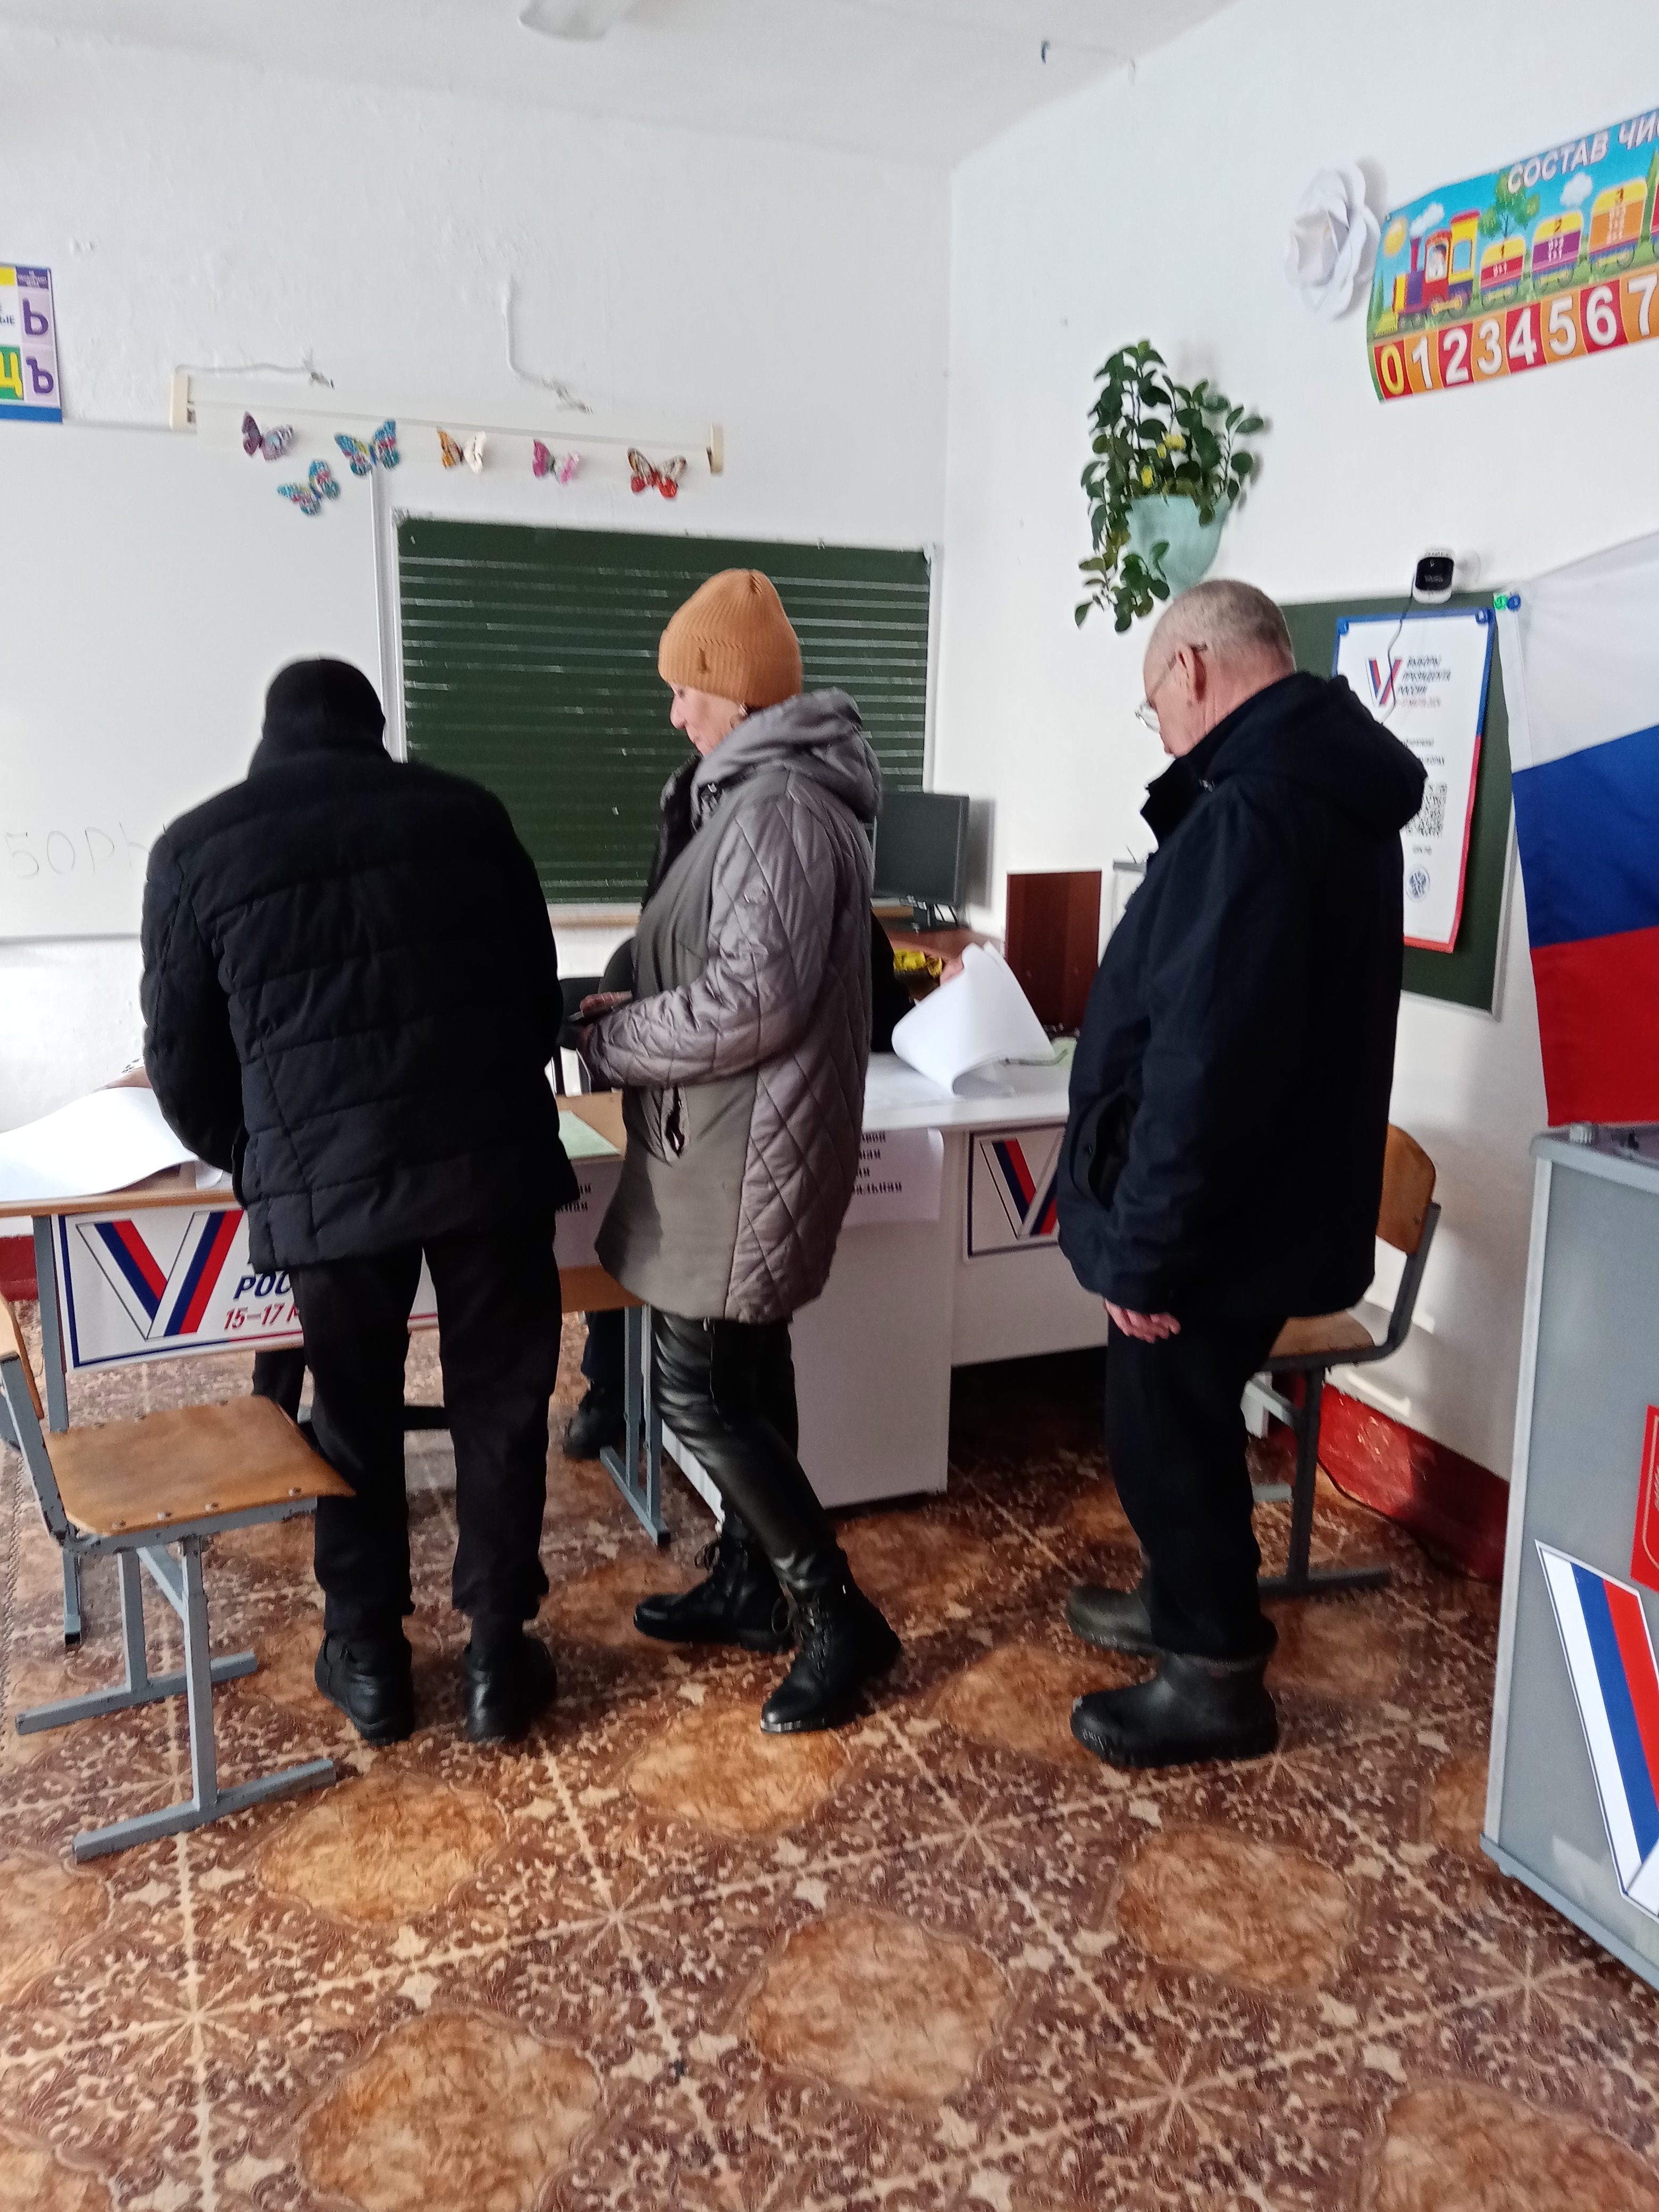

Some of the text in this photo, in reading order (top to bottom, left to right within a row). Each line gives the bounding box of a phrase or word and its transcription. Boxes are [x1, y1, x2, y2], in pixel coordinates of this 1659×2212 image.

[1507, 111, 1659, 194] СОСТАВ ЧИ
[1381, 273, 1659, 396] 0 1 2 3 4 5 6 7
